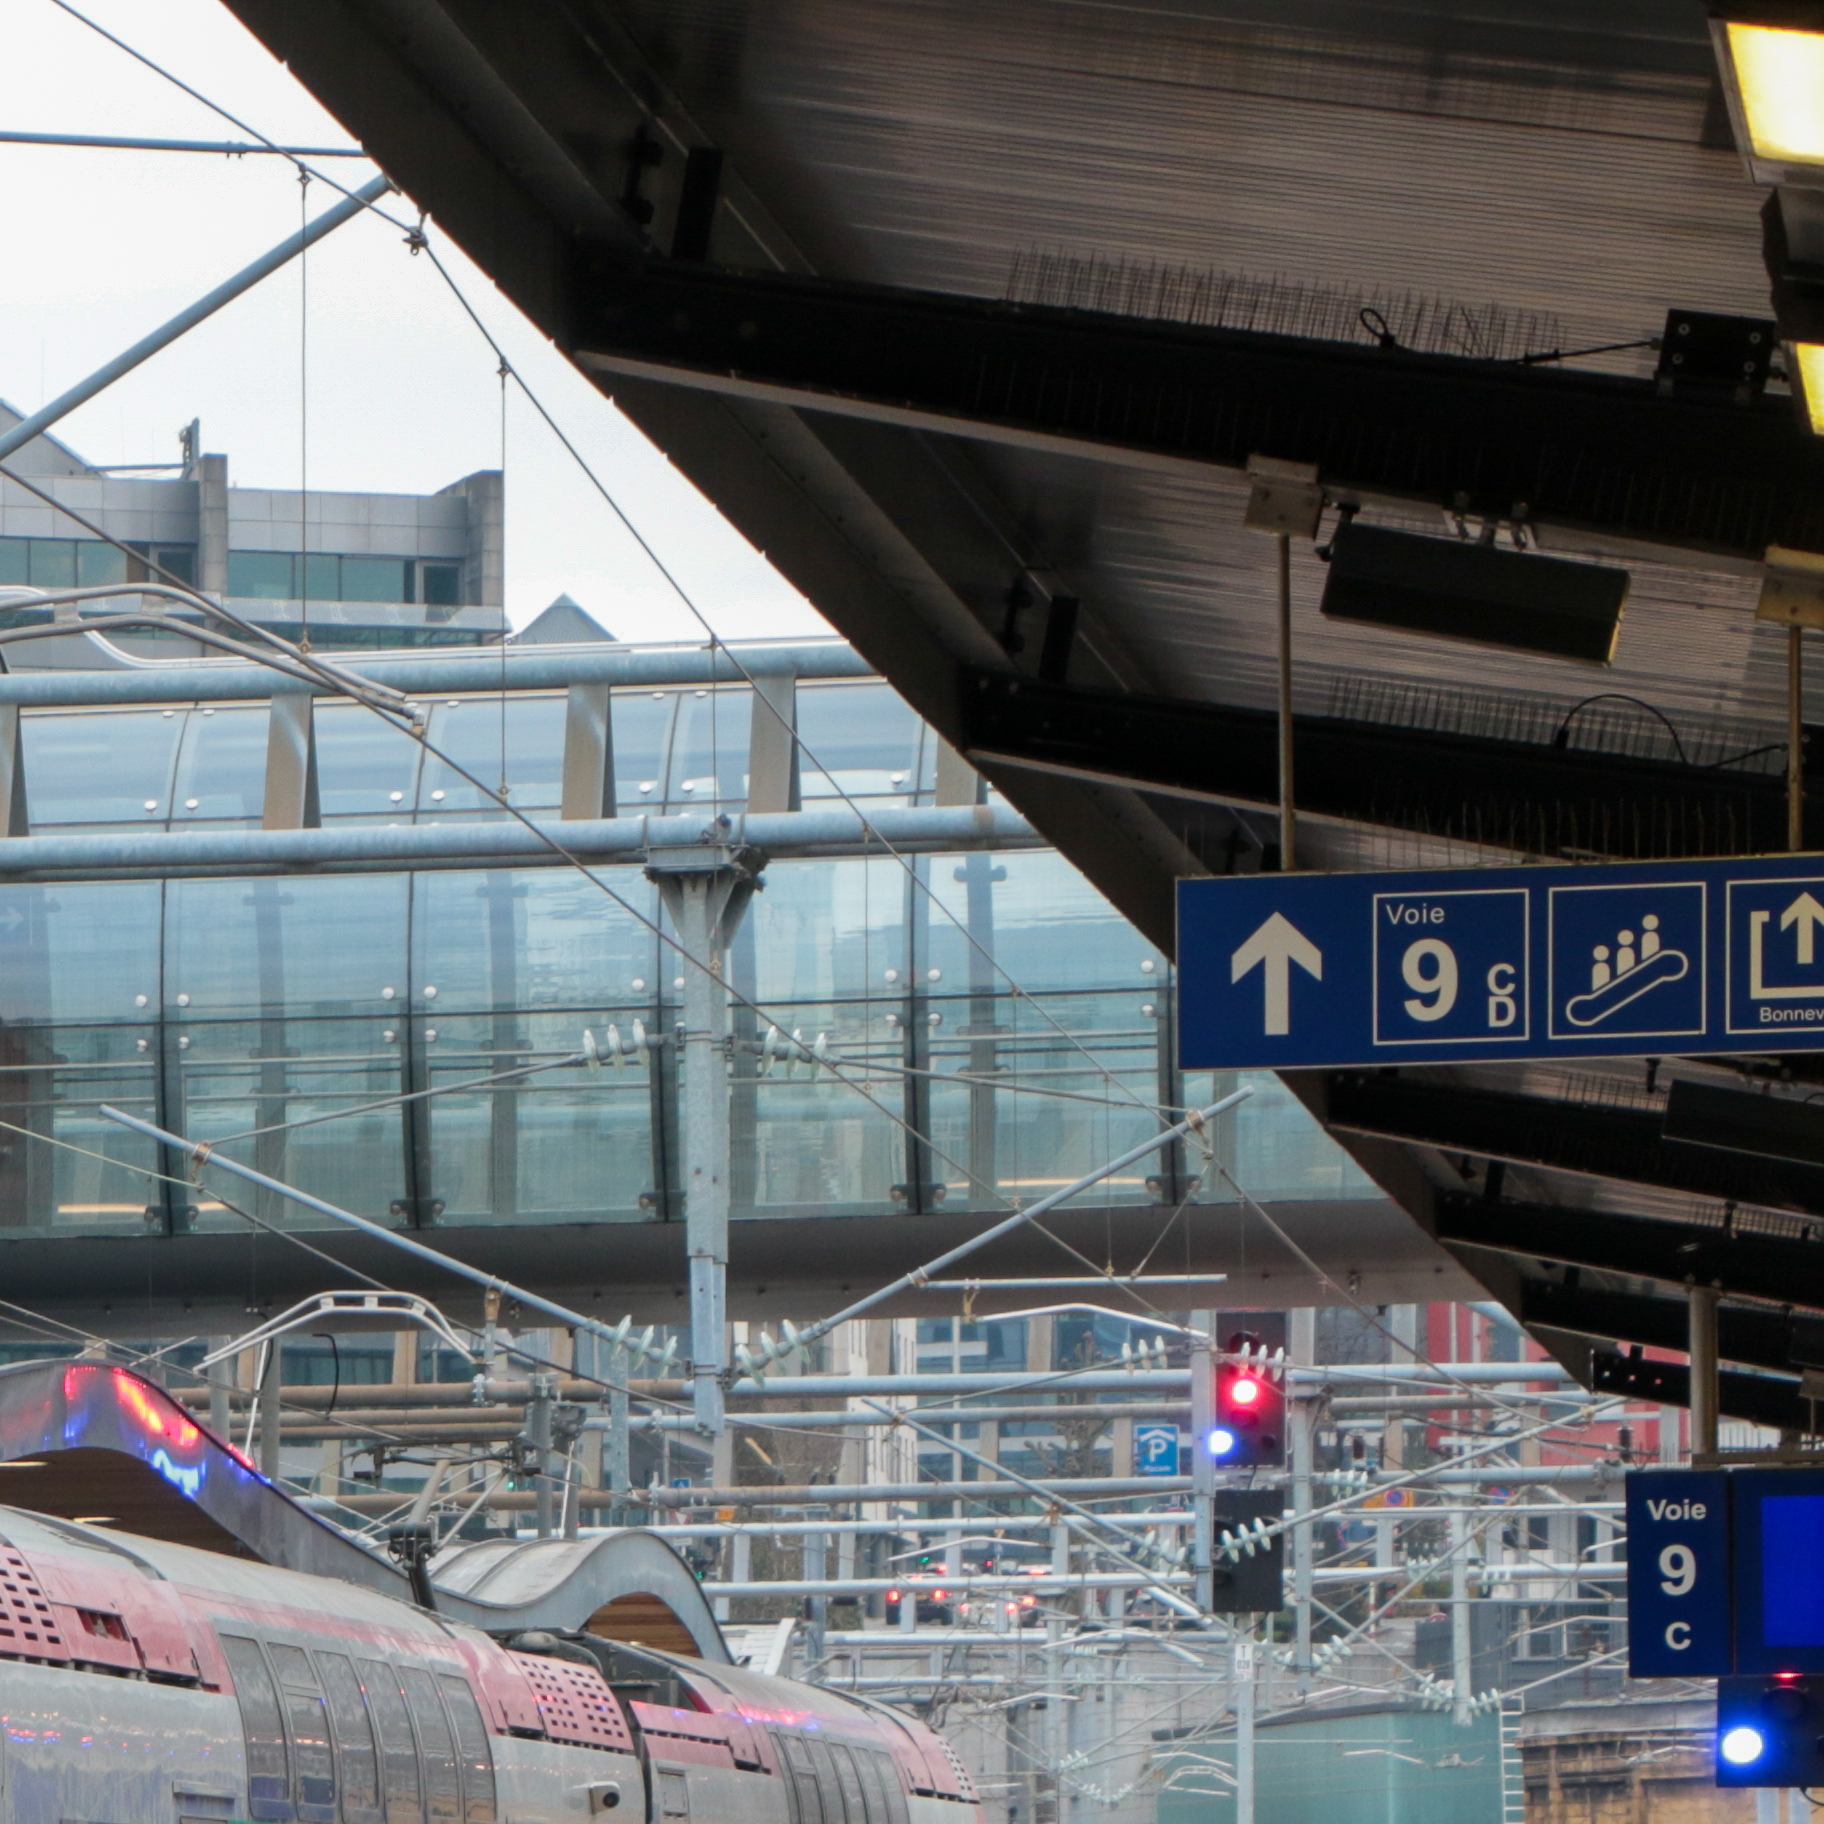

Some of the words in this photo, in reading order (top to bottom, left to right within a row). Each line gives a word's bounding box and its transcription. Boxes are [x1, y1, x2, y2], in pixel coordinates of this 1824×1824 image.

[1385, 902, 1445, 925] Voie
[1402, 937, 1459, 1023] 9
[1486, 962, 1517, 996] C
[1487, 995, 1517, 1028] D
[1646, 1498, 1707, 1521] Voie
[1658, 1543, 1697, 1596] 9
[1664, 1621, 1692, 1651] C
